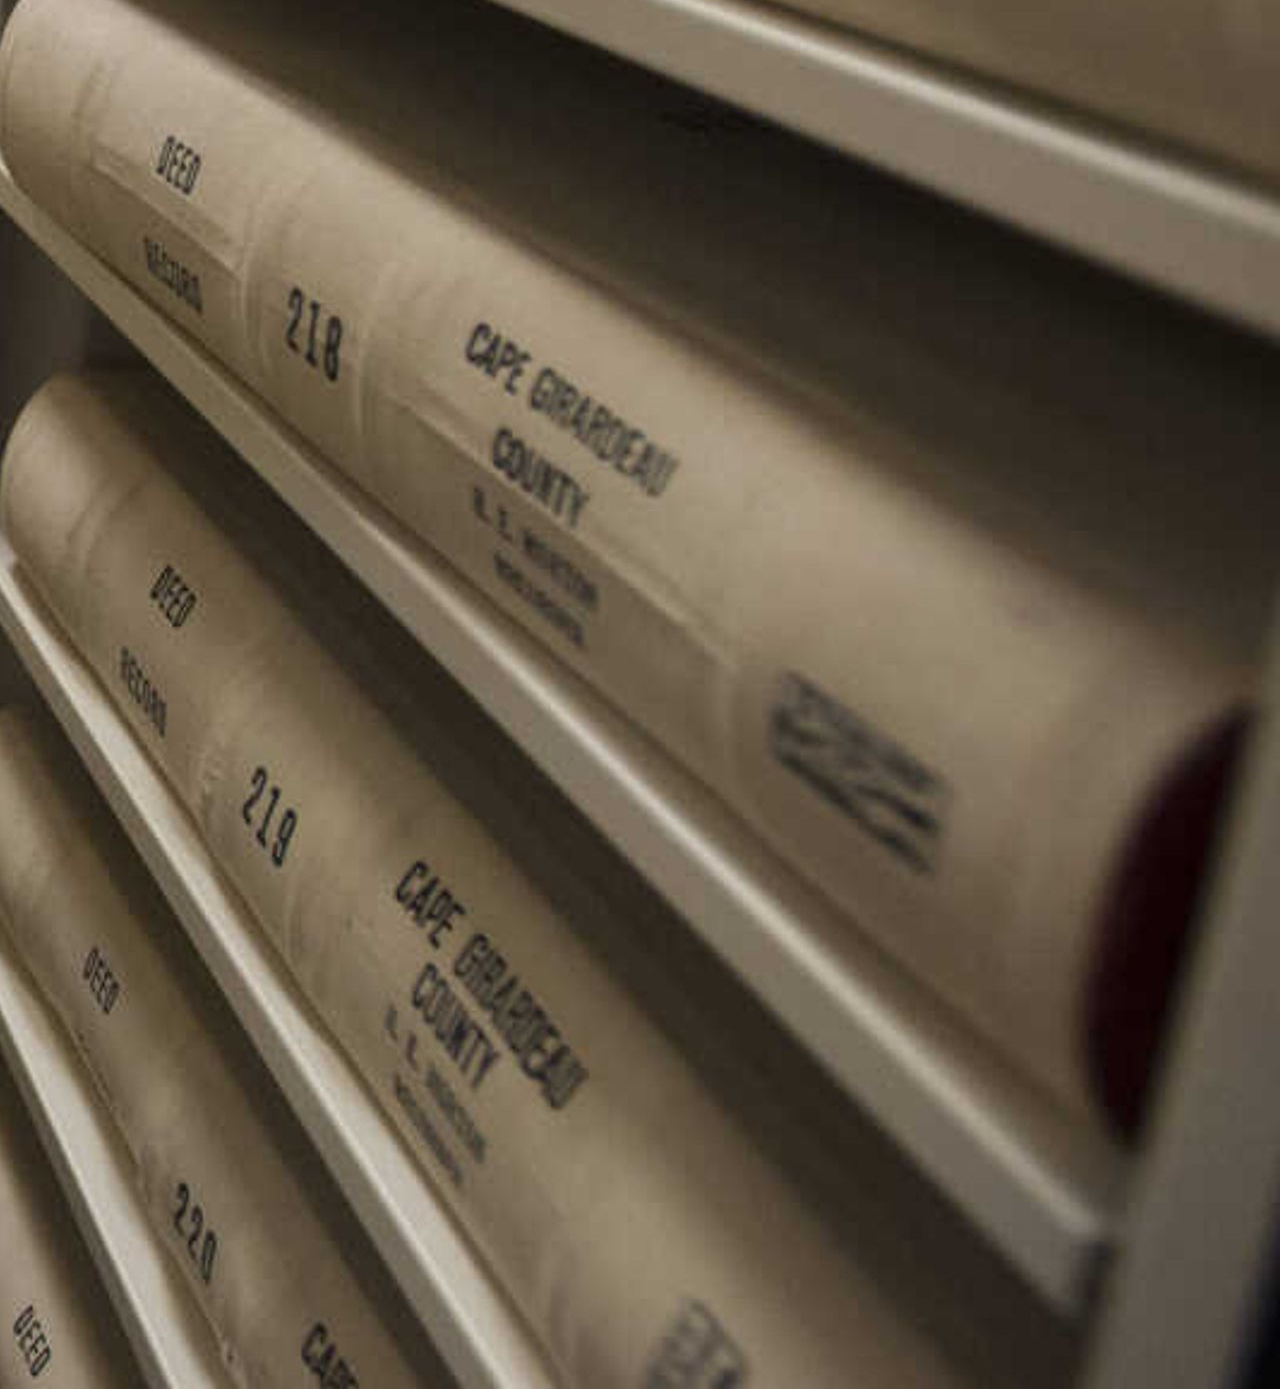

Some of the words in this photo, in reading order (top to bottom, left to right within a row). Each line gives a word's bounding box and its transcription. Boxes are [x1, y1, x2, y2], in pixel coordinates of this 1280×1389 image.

[155, 135, 202, 196] DEED
[286, 286, 343, 383] 218
[465, 322, 532, 396] CAPE
[529, 366, 681, 497] GIRARDEAU
[492, 426, 592, 530] COUNTY
[150, 564, 197, 628] DEED
[81, 945, 121, 1016] DEED
[394, 860, 466, 950] CAPE
[453, 933, 589, 1110] GIRARDEAU
[411, 961, 502, 1093] COUNTY
[173, 1180, 218, 1286] 220
[12, 1303, 52, 1379] DEED
[300, 1321, 360, 1389] CAP
